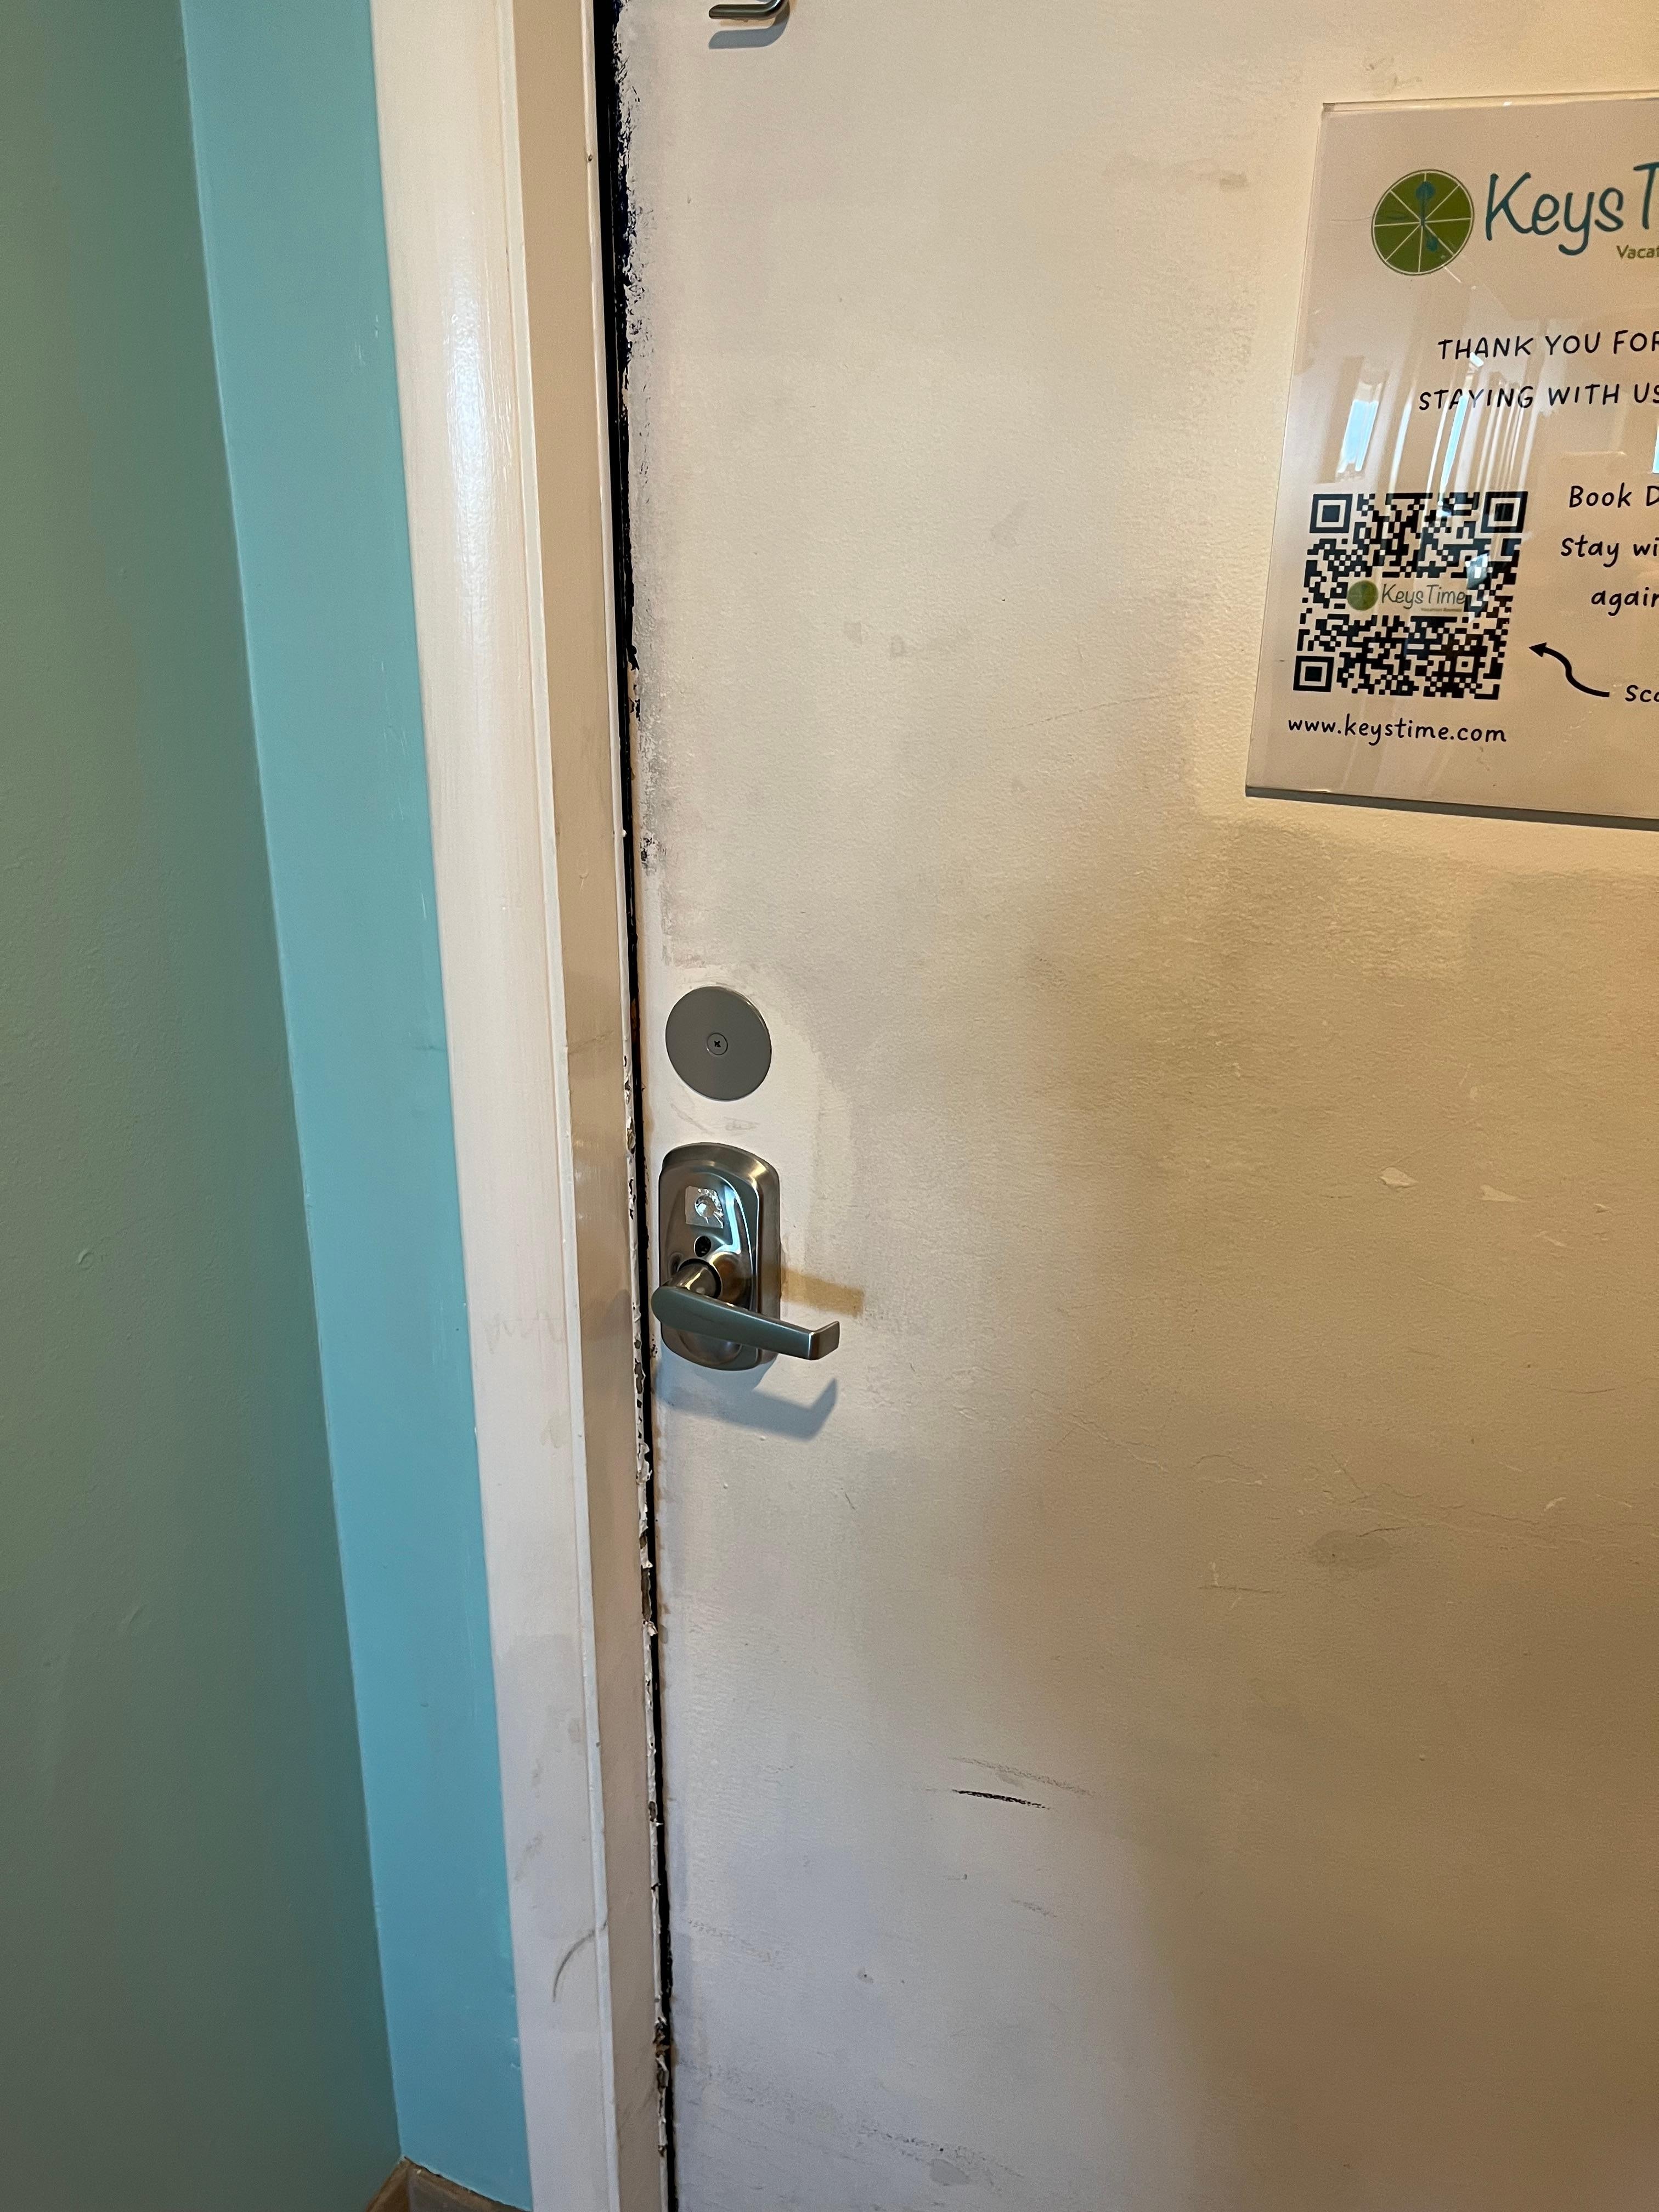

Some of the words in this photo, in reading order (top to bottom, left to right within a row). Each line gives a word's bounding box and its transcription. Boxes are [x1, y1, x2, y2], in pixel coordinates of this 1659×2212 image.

[1438, 335, 1534, 359] THANK
[1545, 332, 1601, 356] YOU
[1419, 386, 1533, 410] STAYING
[1548, 383, 1620, 405] WITH
[1569, 482, 1632, 508] Book
[1561, 534, 1620, 568] Stay
[1288, 713, 1506, 746] www.keystime.com
